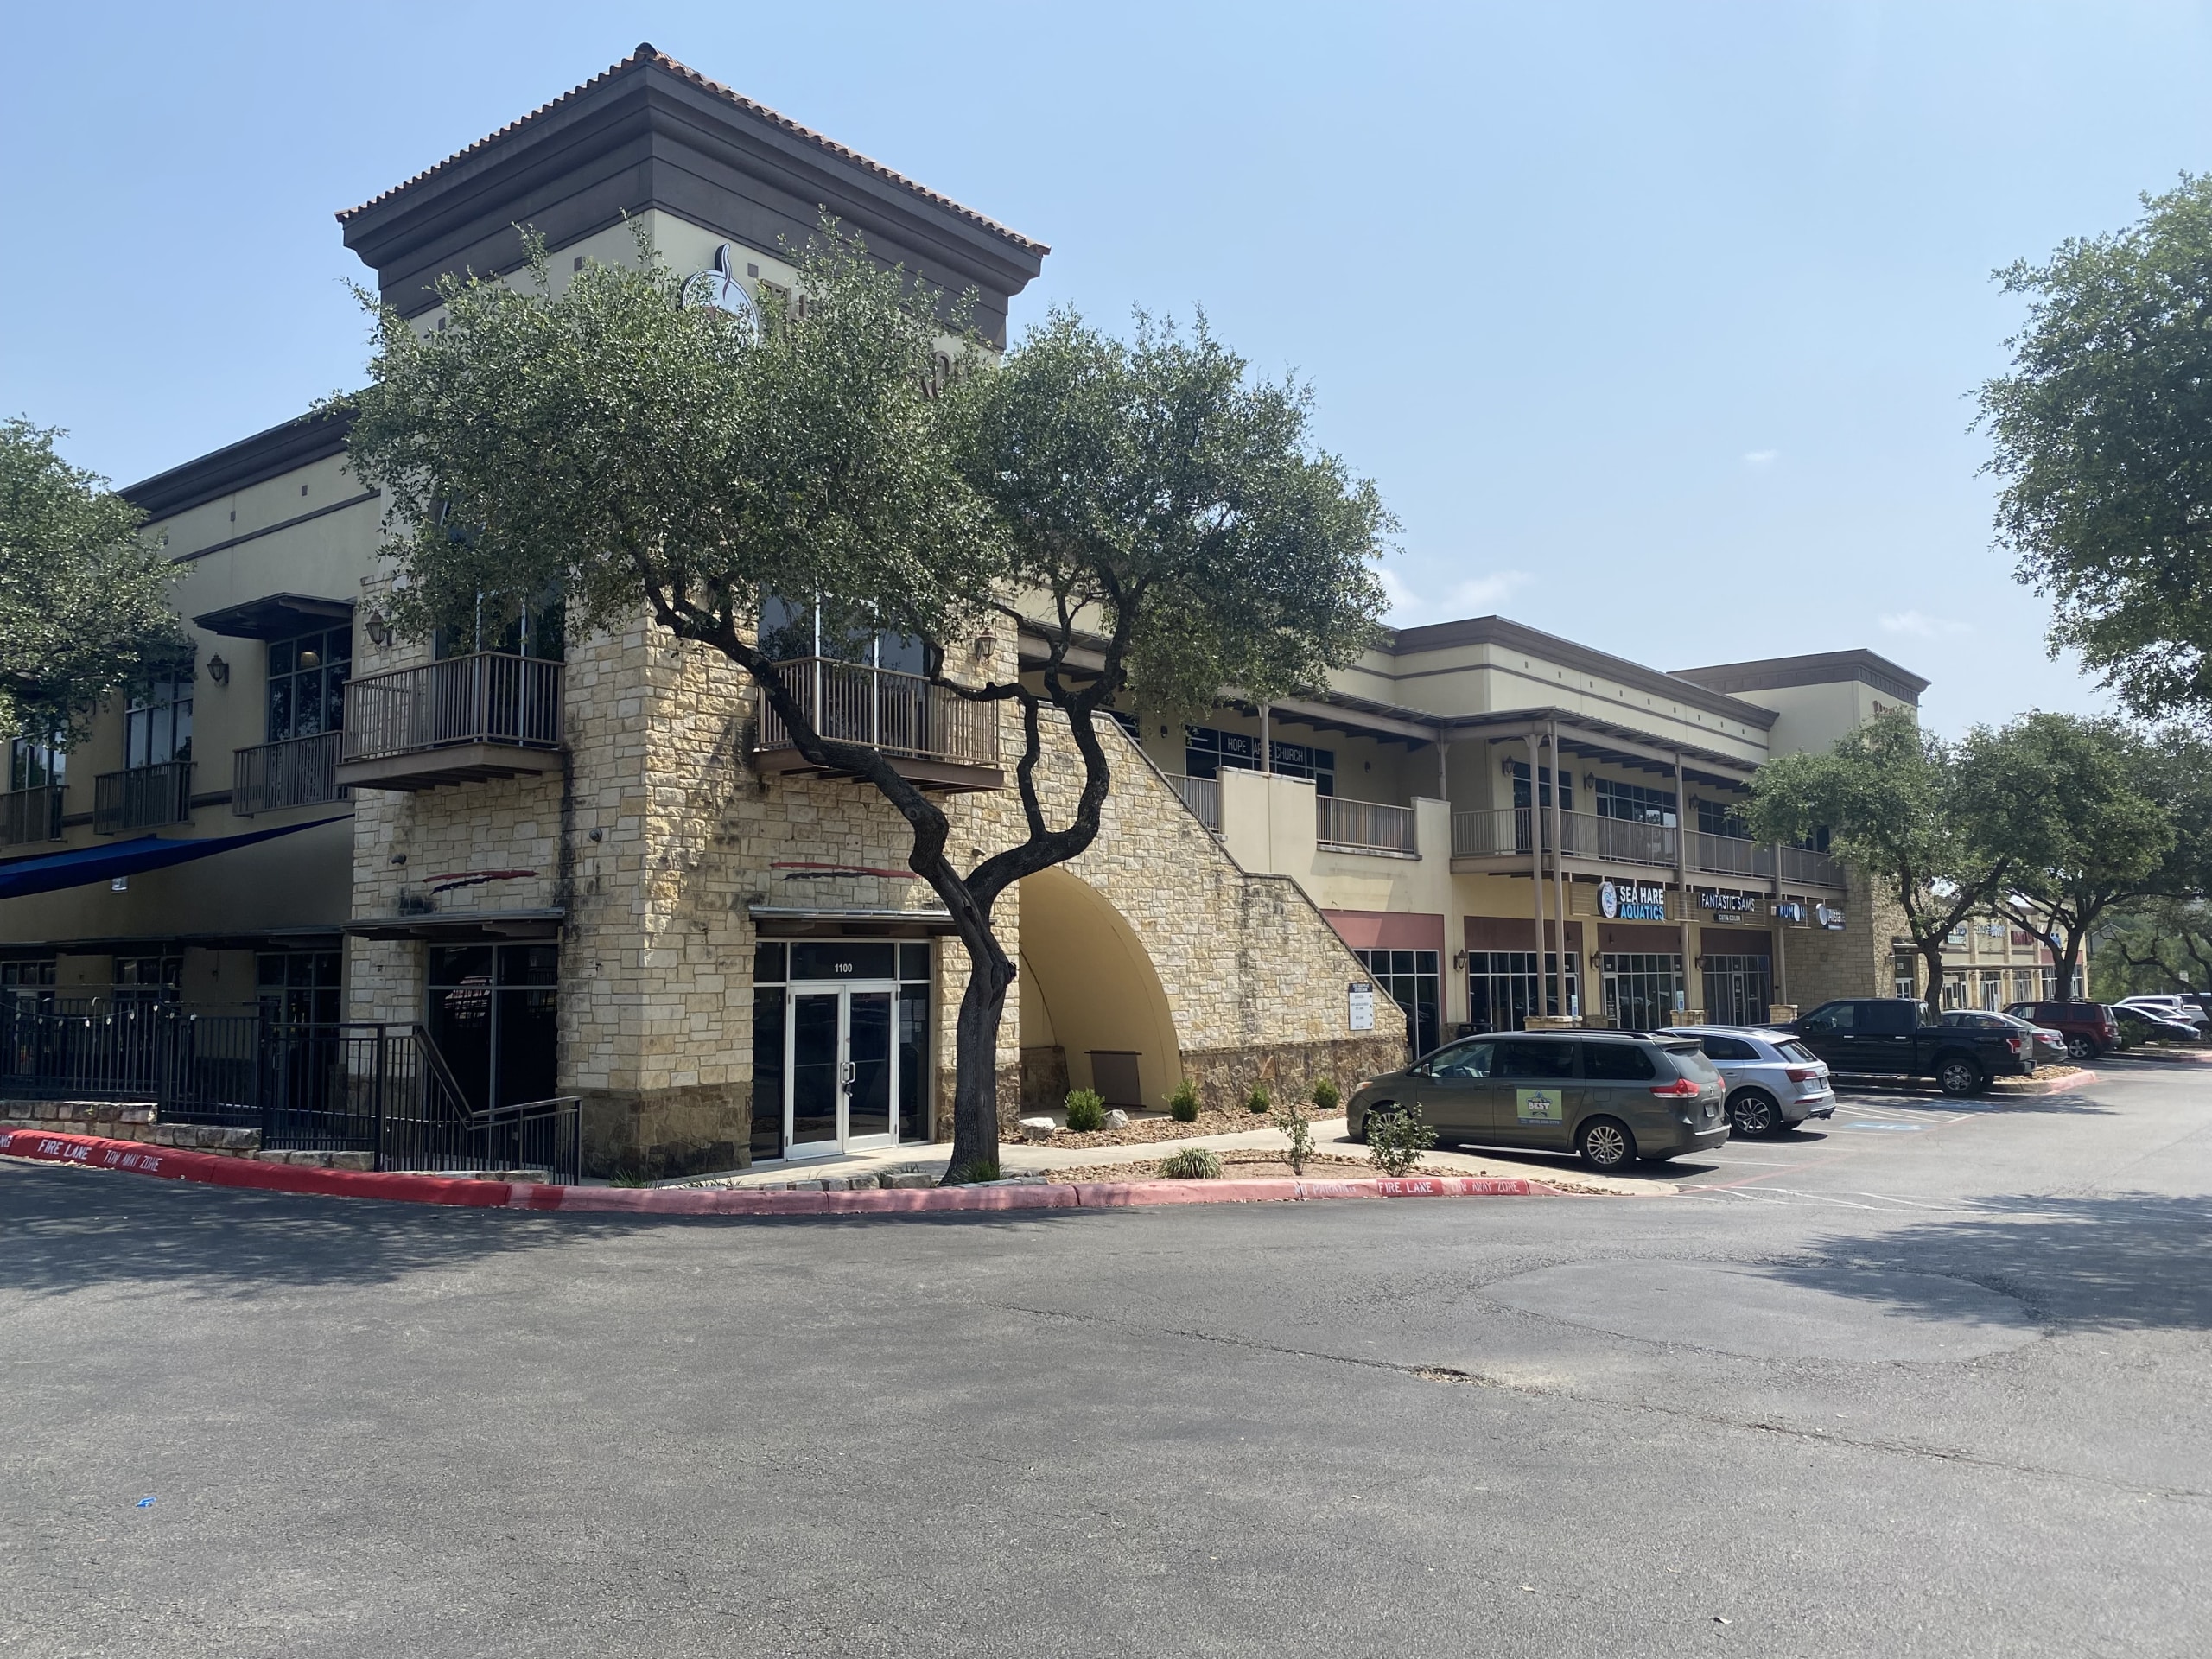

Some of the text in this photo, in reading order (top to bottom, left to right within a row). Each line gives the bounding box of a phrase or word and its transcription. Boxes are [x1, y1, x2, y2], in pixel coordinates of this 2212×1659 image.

[1227, 737, 1246, 753] HOPE
[1275, 746, 1304, 763] CHURCH
[1619, 885, 1664, 905] SEA HARE
[1701, 893, 1736, 911] FANTASTIC
[1619, 903, 1664, 920] AQUATICS
[1779, 902, 1805, 922] KUMON
[835, 963, 853, 973] 1100
[1528, 1102, 1550, 1110] BEST
[37, 1139, 163, 1172] FIRE LANE TOW AWAY ZONE
[1294, 1183, 1308, 1195] NO
[1313, 1182, 1357, 1195] PARKING
[1378, 1181, 1402, 1193] FIRE
[1406, 1181, 1433, 1193] LANE
[1472, 1181, 1491, 1192] AWAY
[1496, 1181, 1521, 1192] ZONE
